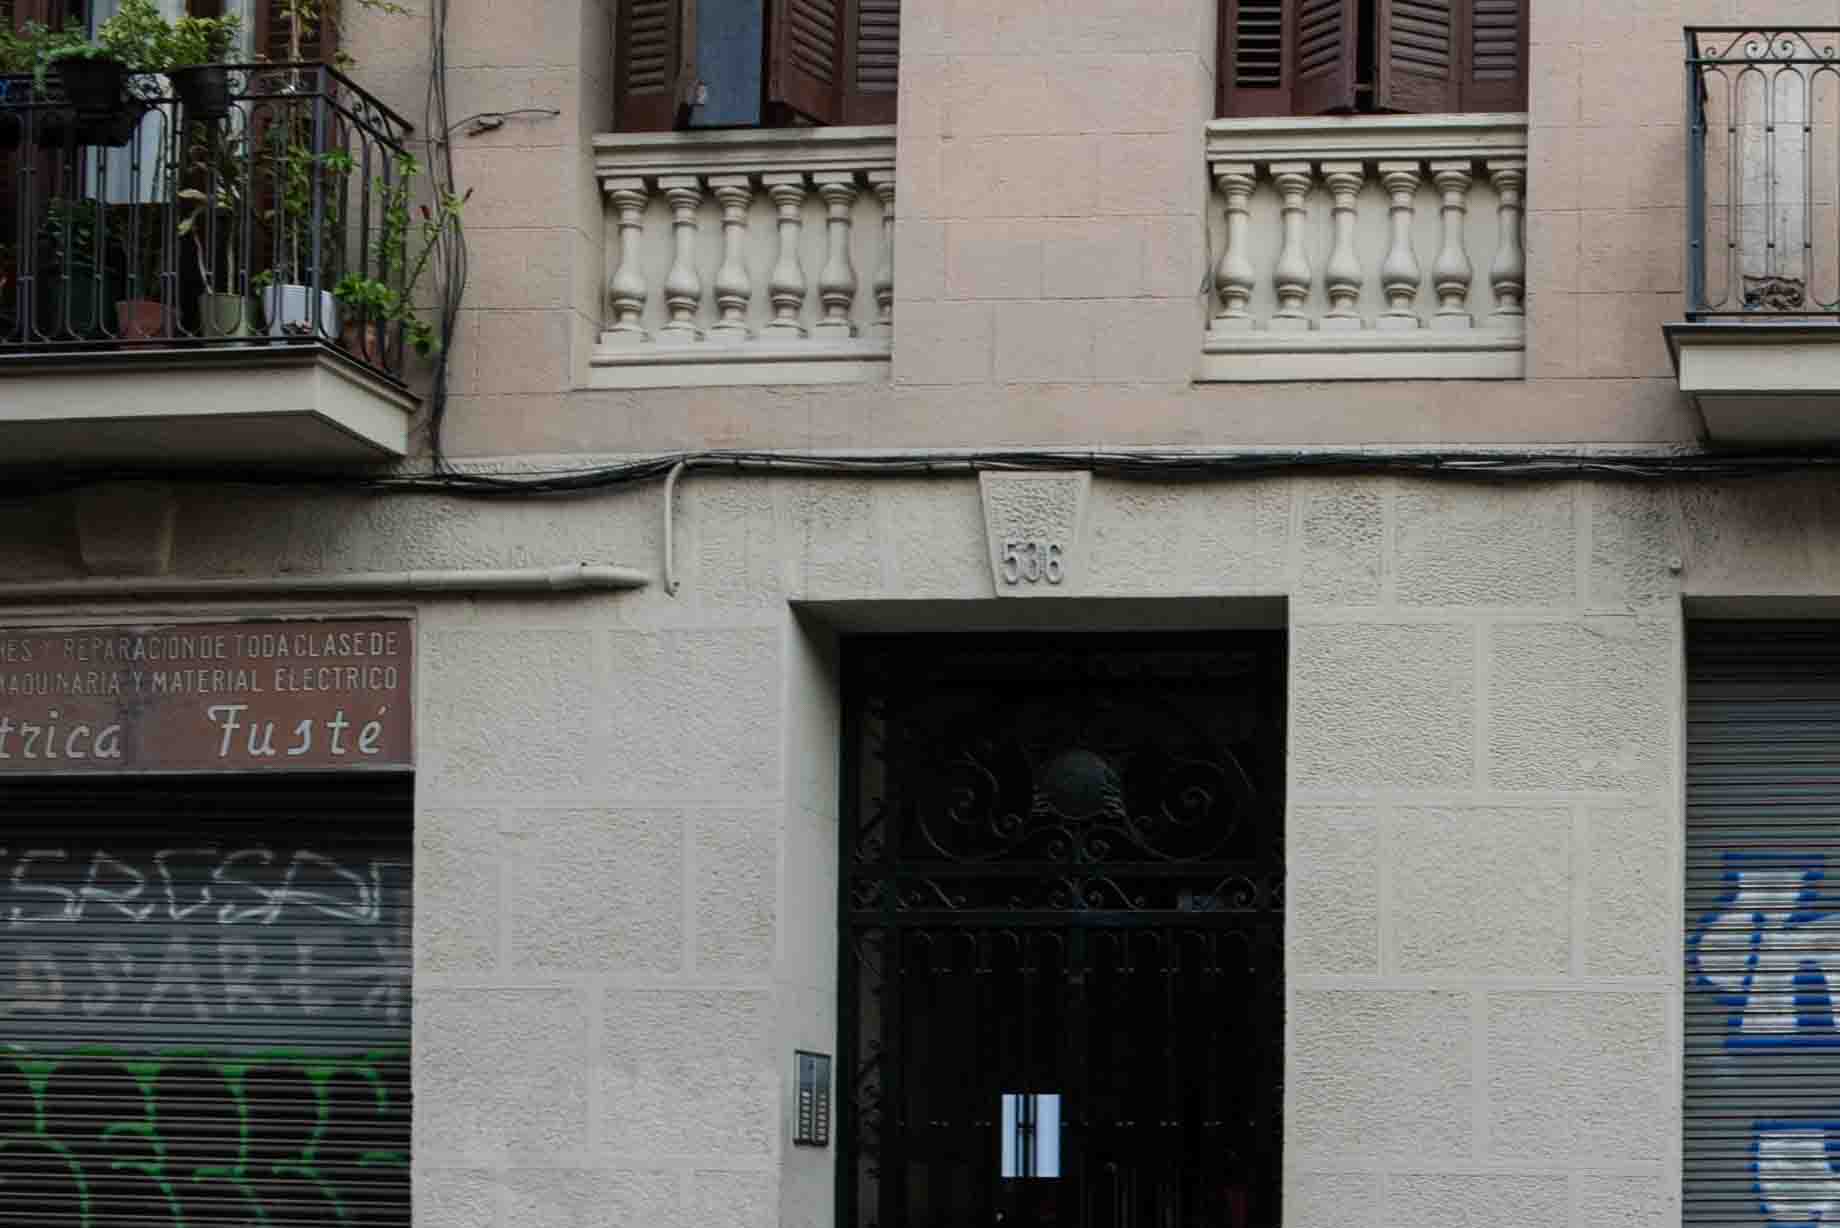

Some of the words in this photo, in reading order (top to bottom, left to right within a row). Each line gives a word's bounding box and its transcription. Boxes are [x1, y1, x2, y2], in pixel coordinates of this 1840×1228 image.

[200, 635, 228, 659] DE
[233, 633, 290, 658] TODA
[294, 632, 367, 657] CLASE
[370, 631, 399, 656] DE
[129, 671, 144, 695] Y
[151, 667, 264, 695] MATERIAL
[274, 665, 399, 693] ELECTRICO
[207, 704, 387, 757] Fusté
